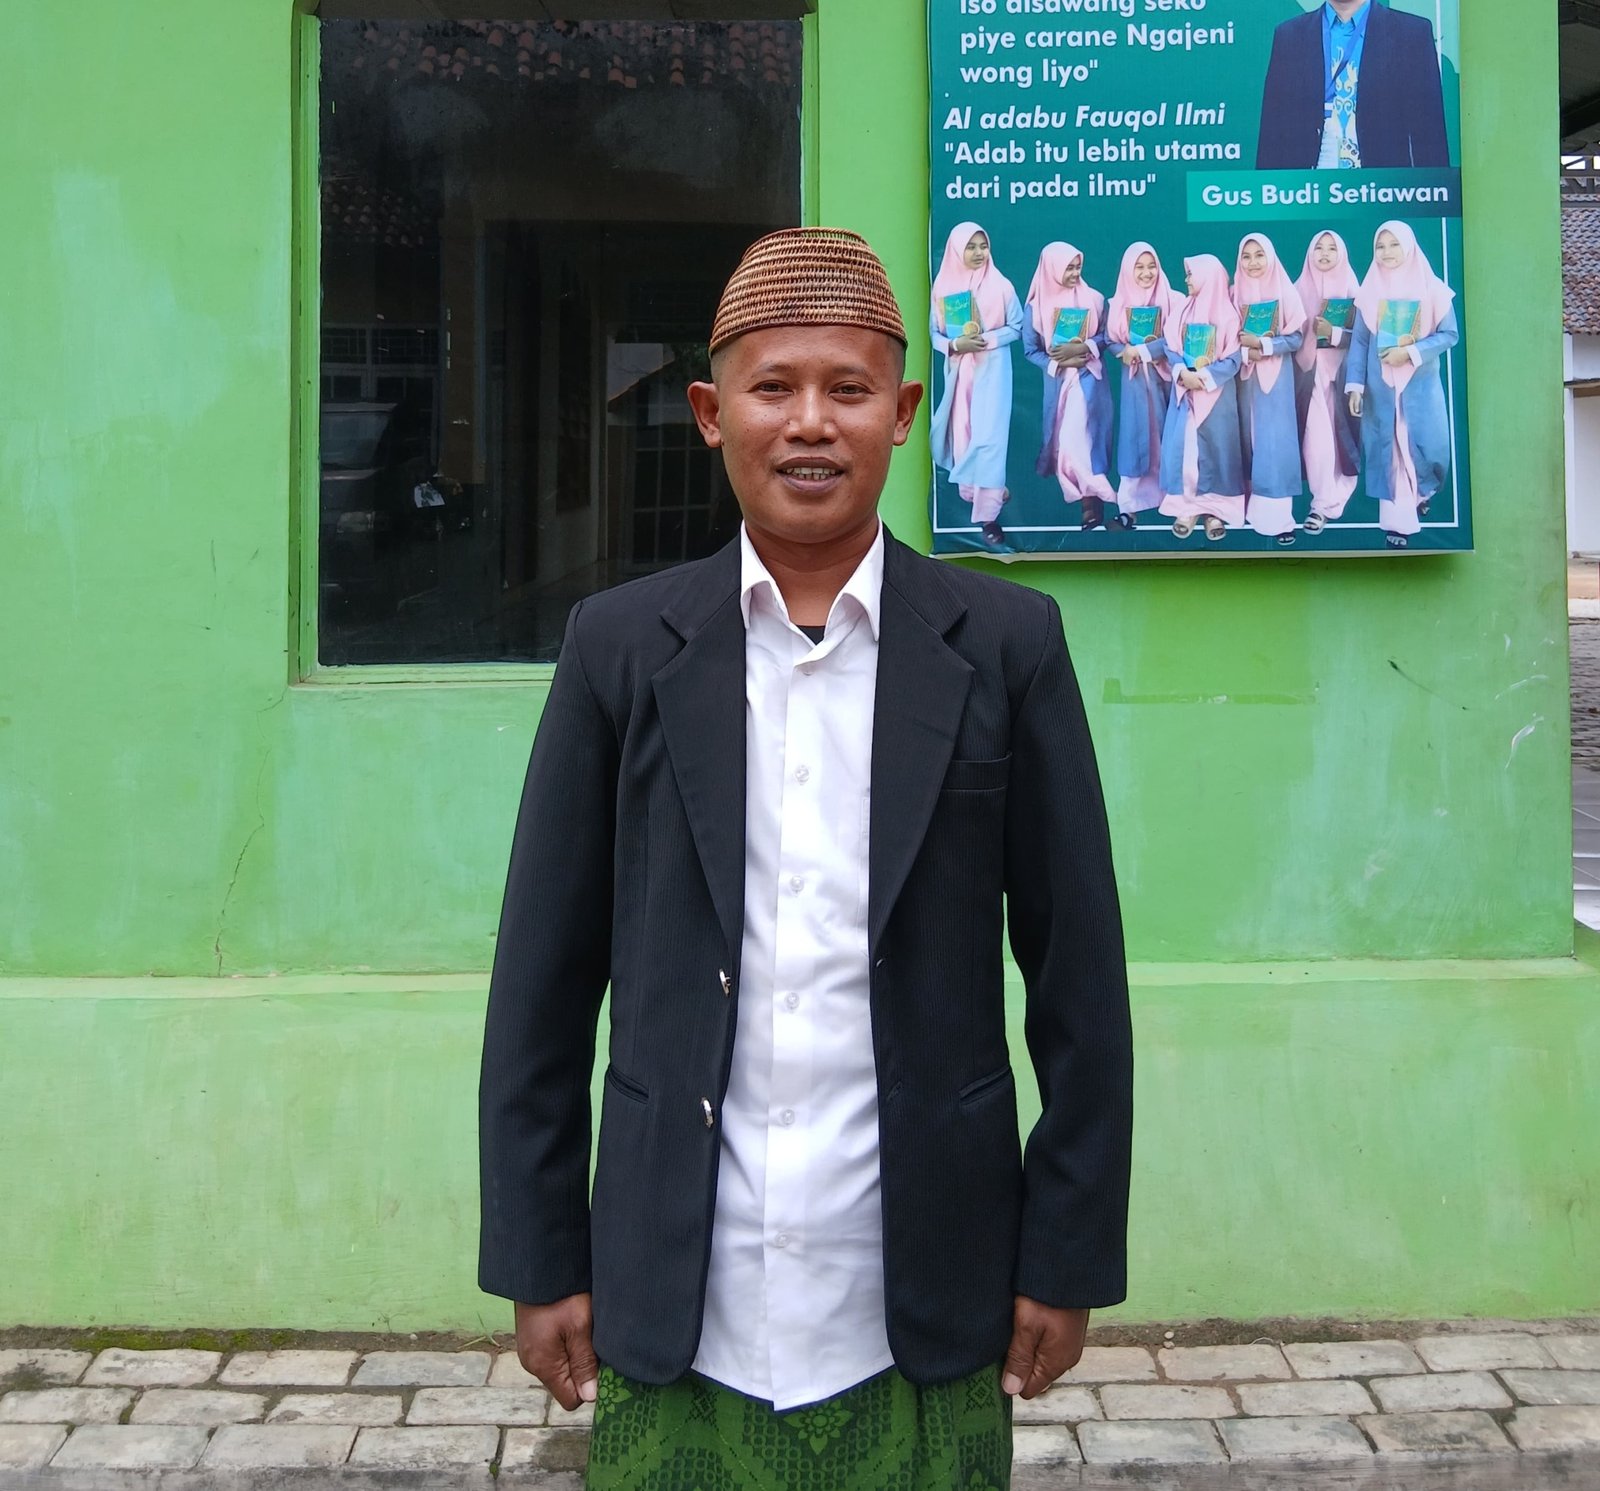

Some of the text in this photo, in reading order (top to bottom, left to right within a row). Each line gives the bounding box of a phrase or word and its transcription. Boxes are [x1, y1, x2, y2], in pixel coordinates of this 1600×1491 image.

[1006, 0, 1134, 17] disawang
[961, 22, 1234, 54] piye carane Ngajeni
[960, 59, 1098, 88] wong liyo"
[943, 102, 1226, 132] Al adabu Fauqol Ilmi
[945, 138, 1240, 164] "Adab itu lebih utama
[946, 173, 1156, 203] dari pada ilmu"
[1202, 182, 1449, 206] Gus Budi Setiawan
